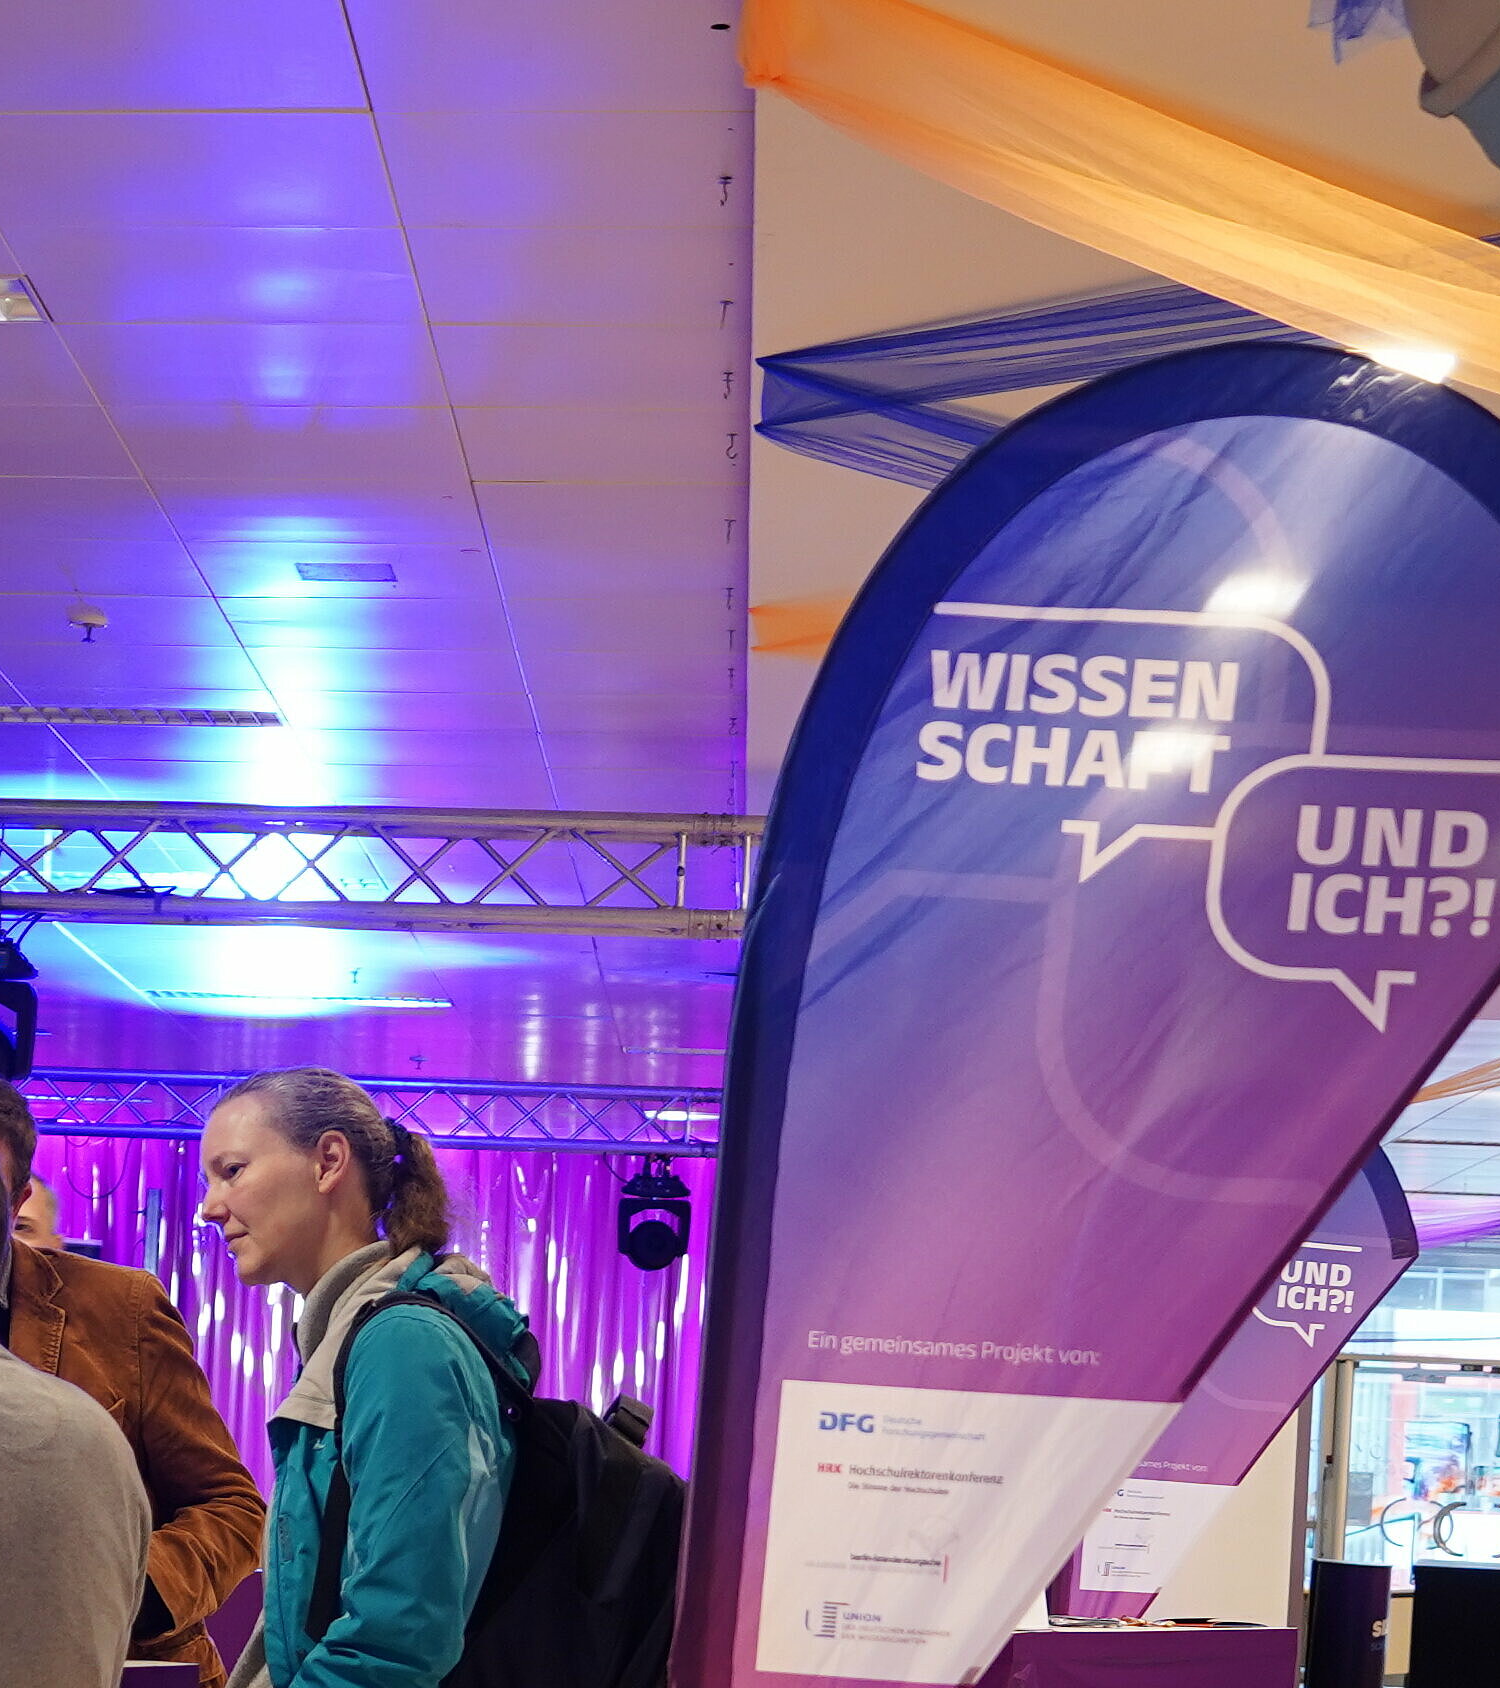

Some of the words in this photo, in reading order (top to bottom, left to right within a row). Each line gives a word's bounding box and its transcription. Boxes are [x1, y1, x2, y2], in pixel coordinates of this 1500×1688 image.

[929, 648, 1240, 723] WISSEN
[915, 719, 1231, 794] SCHAFT
[1296, 803, 1488, 869] UND
[1287, 873, 1496, 938] ICH?!
[1281, 1260, 1352, 1287] UND
[1276, 1285, 1355, 1314] ICH?!
[807, 1330, 837, 1350] Ein
[840, 1334, 977, 1359] gemeinsames
[981, 1341, 1054, 1365] Projekt
[1058, 1349, 1100, 1366] von:
[819, 1412, 874, 1433] DFG
[817, 1463, 842, 1474] HRK
[849, 1465, 1004, 1485] Hochschulrektorenkonferenz
